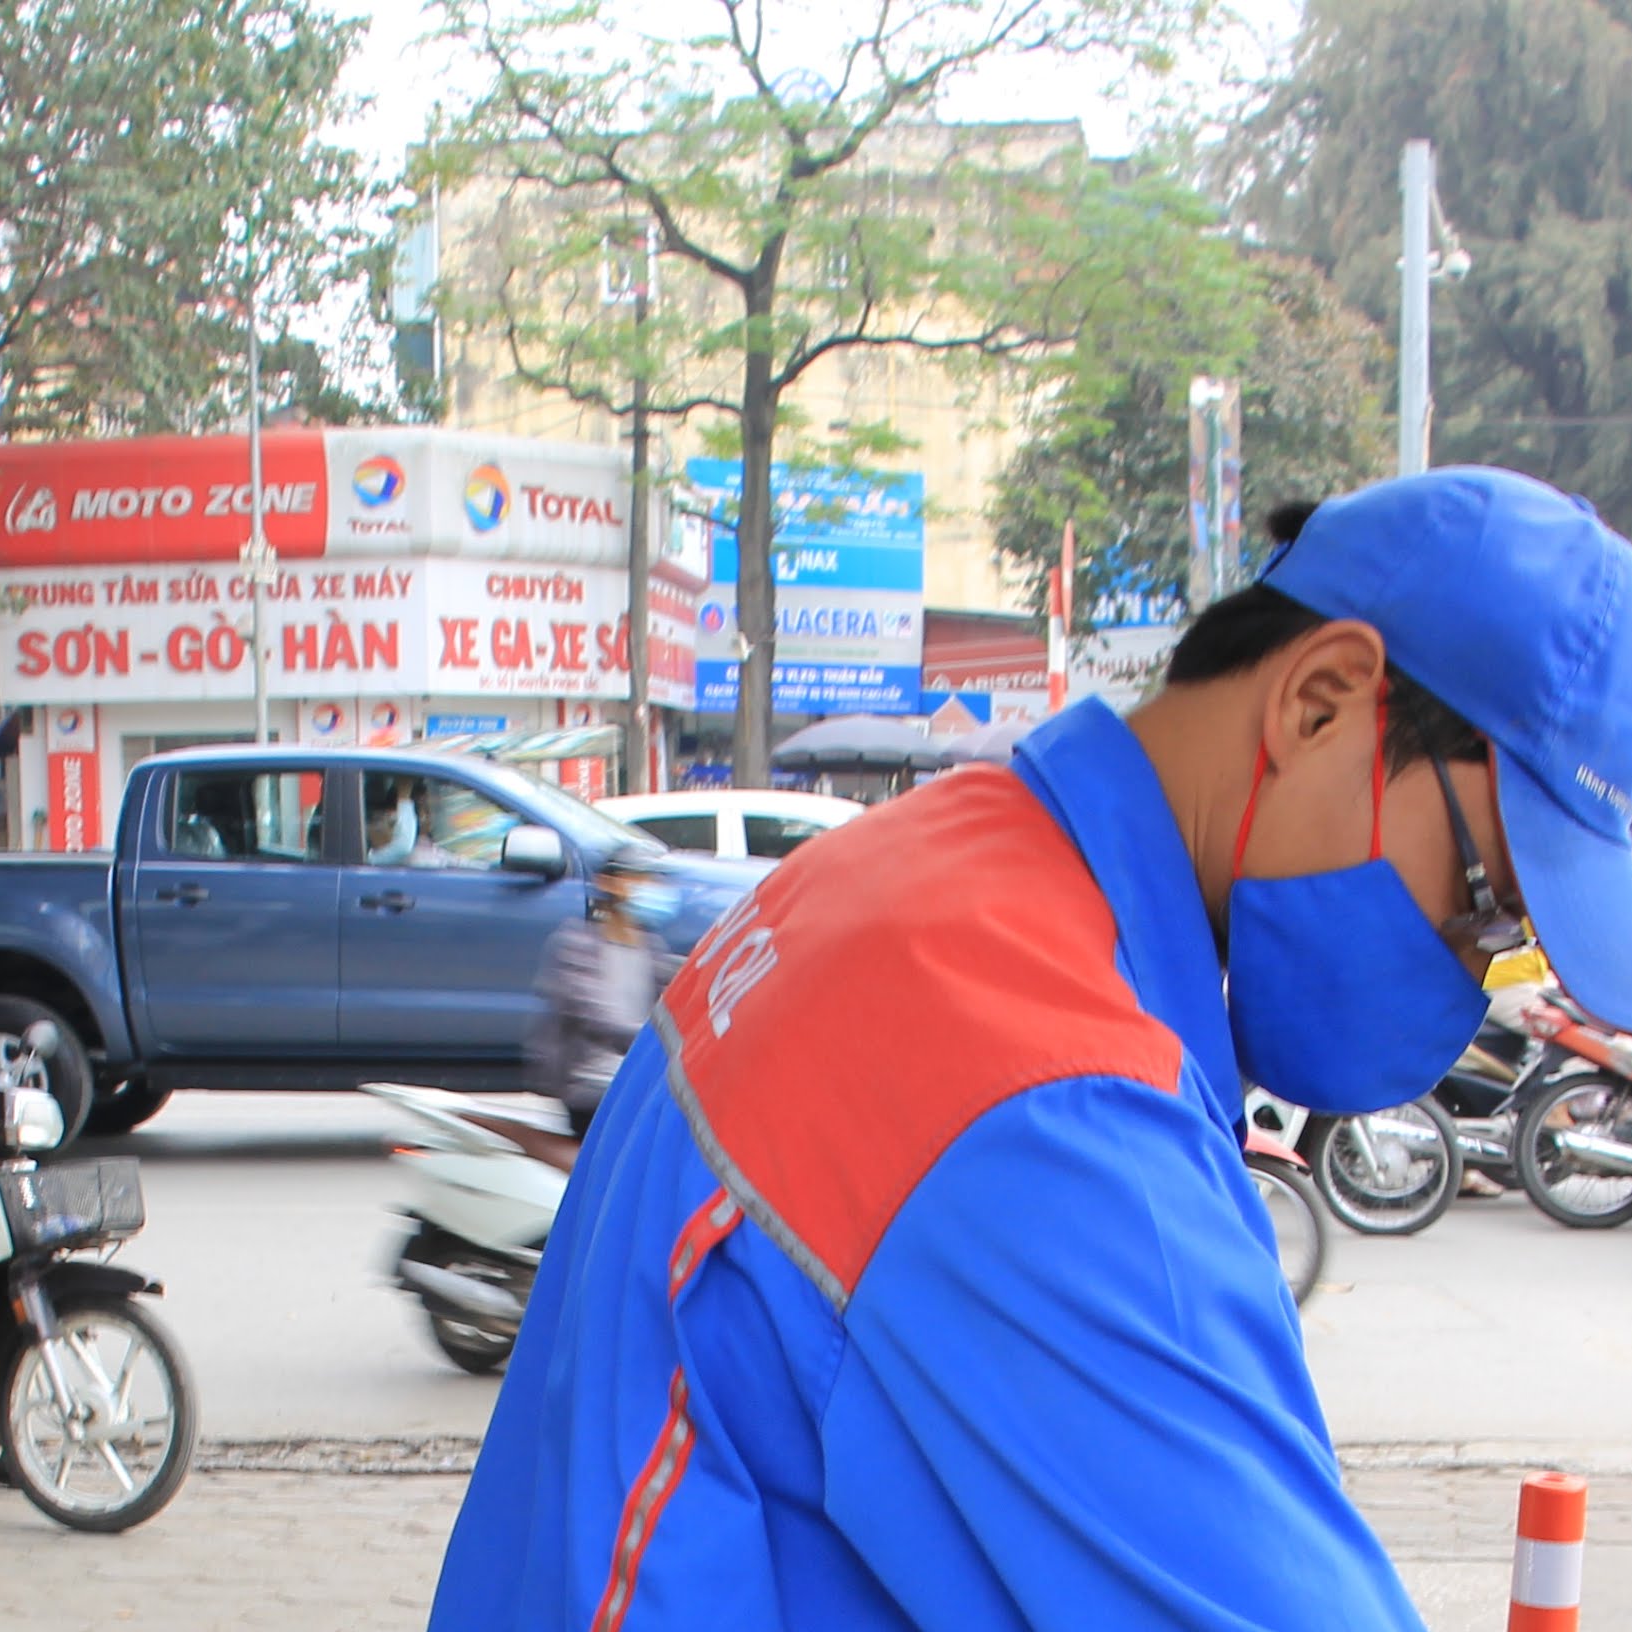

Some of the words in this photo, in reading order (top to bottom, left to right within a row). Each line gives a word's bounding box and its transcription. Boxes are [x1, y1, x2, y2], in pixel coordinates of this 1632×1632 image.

[72, 485, 193, 520] MOTO
[522, 485, 624, 527] TOTAL
[104, 574, 159, 605] TÂM
[313, 574, 345, 599] XE
[354, 566, 413, 598] MÁY
[486, 571, 583, 603] CHUYÊN
[17, 623, 130, 677] SƠN
[282, 608, 398, 671] HÀN
[440, 617, 479, 668] XE
